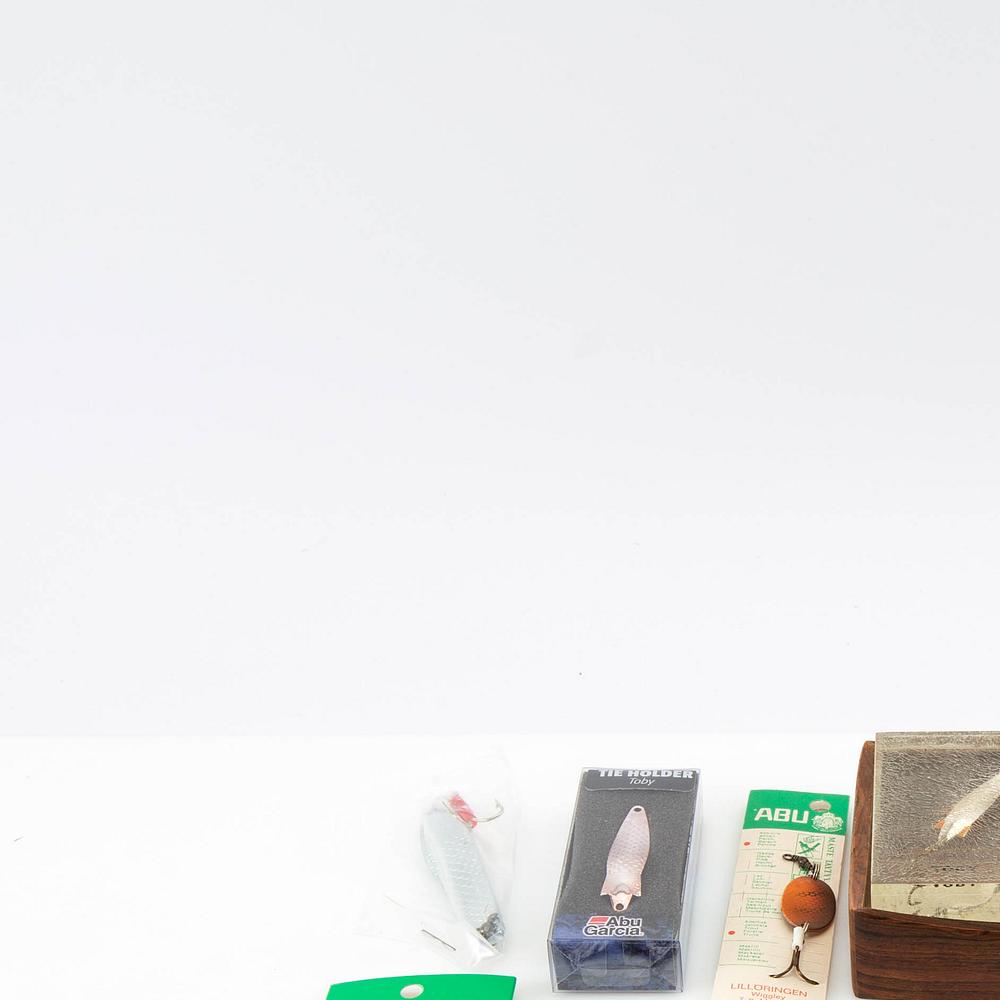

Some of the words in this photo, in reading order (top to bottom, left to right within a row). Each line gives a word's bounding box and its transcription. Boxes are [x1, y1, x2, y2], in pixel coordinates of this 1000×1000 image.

[599, 769, 623, 777] TIE
[627, 769, 694, 779] HOLDER
[629, 778, 655, 786] Toby
[754, 808, 809, 824] ABU
[605, 915, 643, 927] Abu
[583, 925, 642, 936] Garcia
[751, 991, 787, 1000] Wiggley
